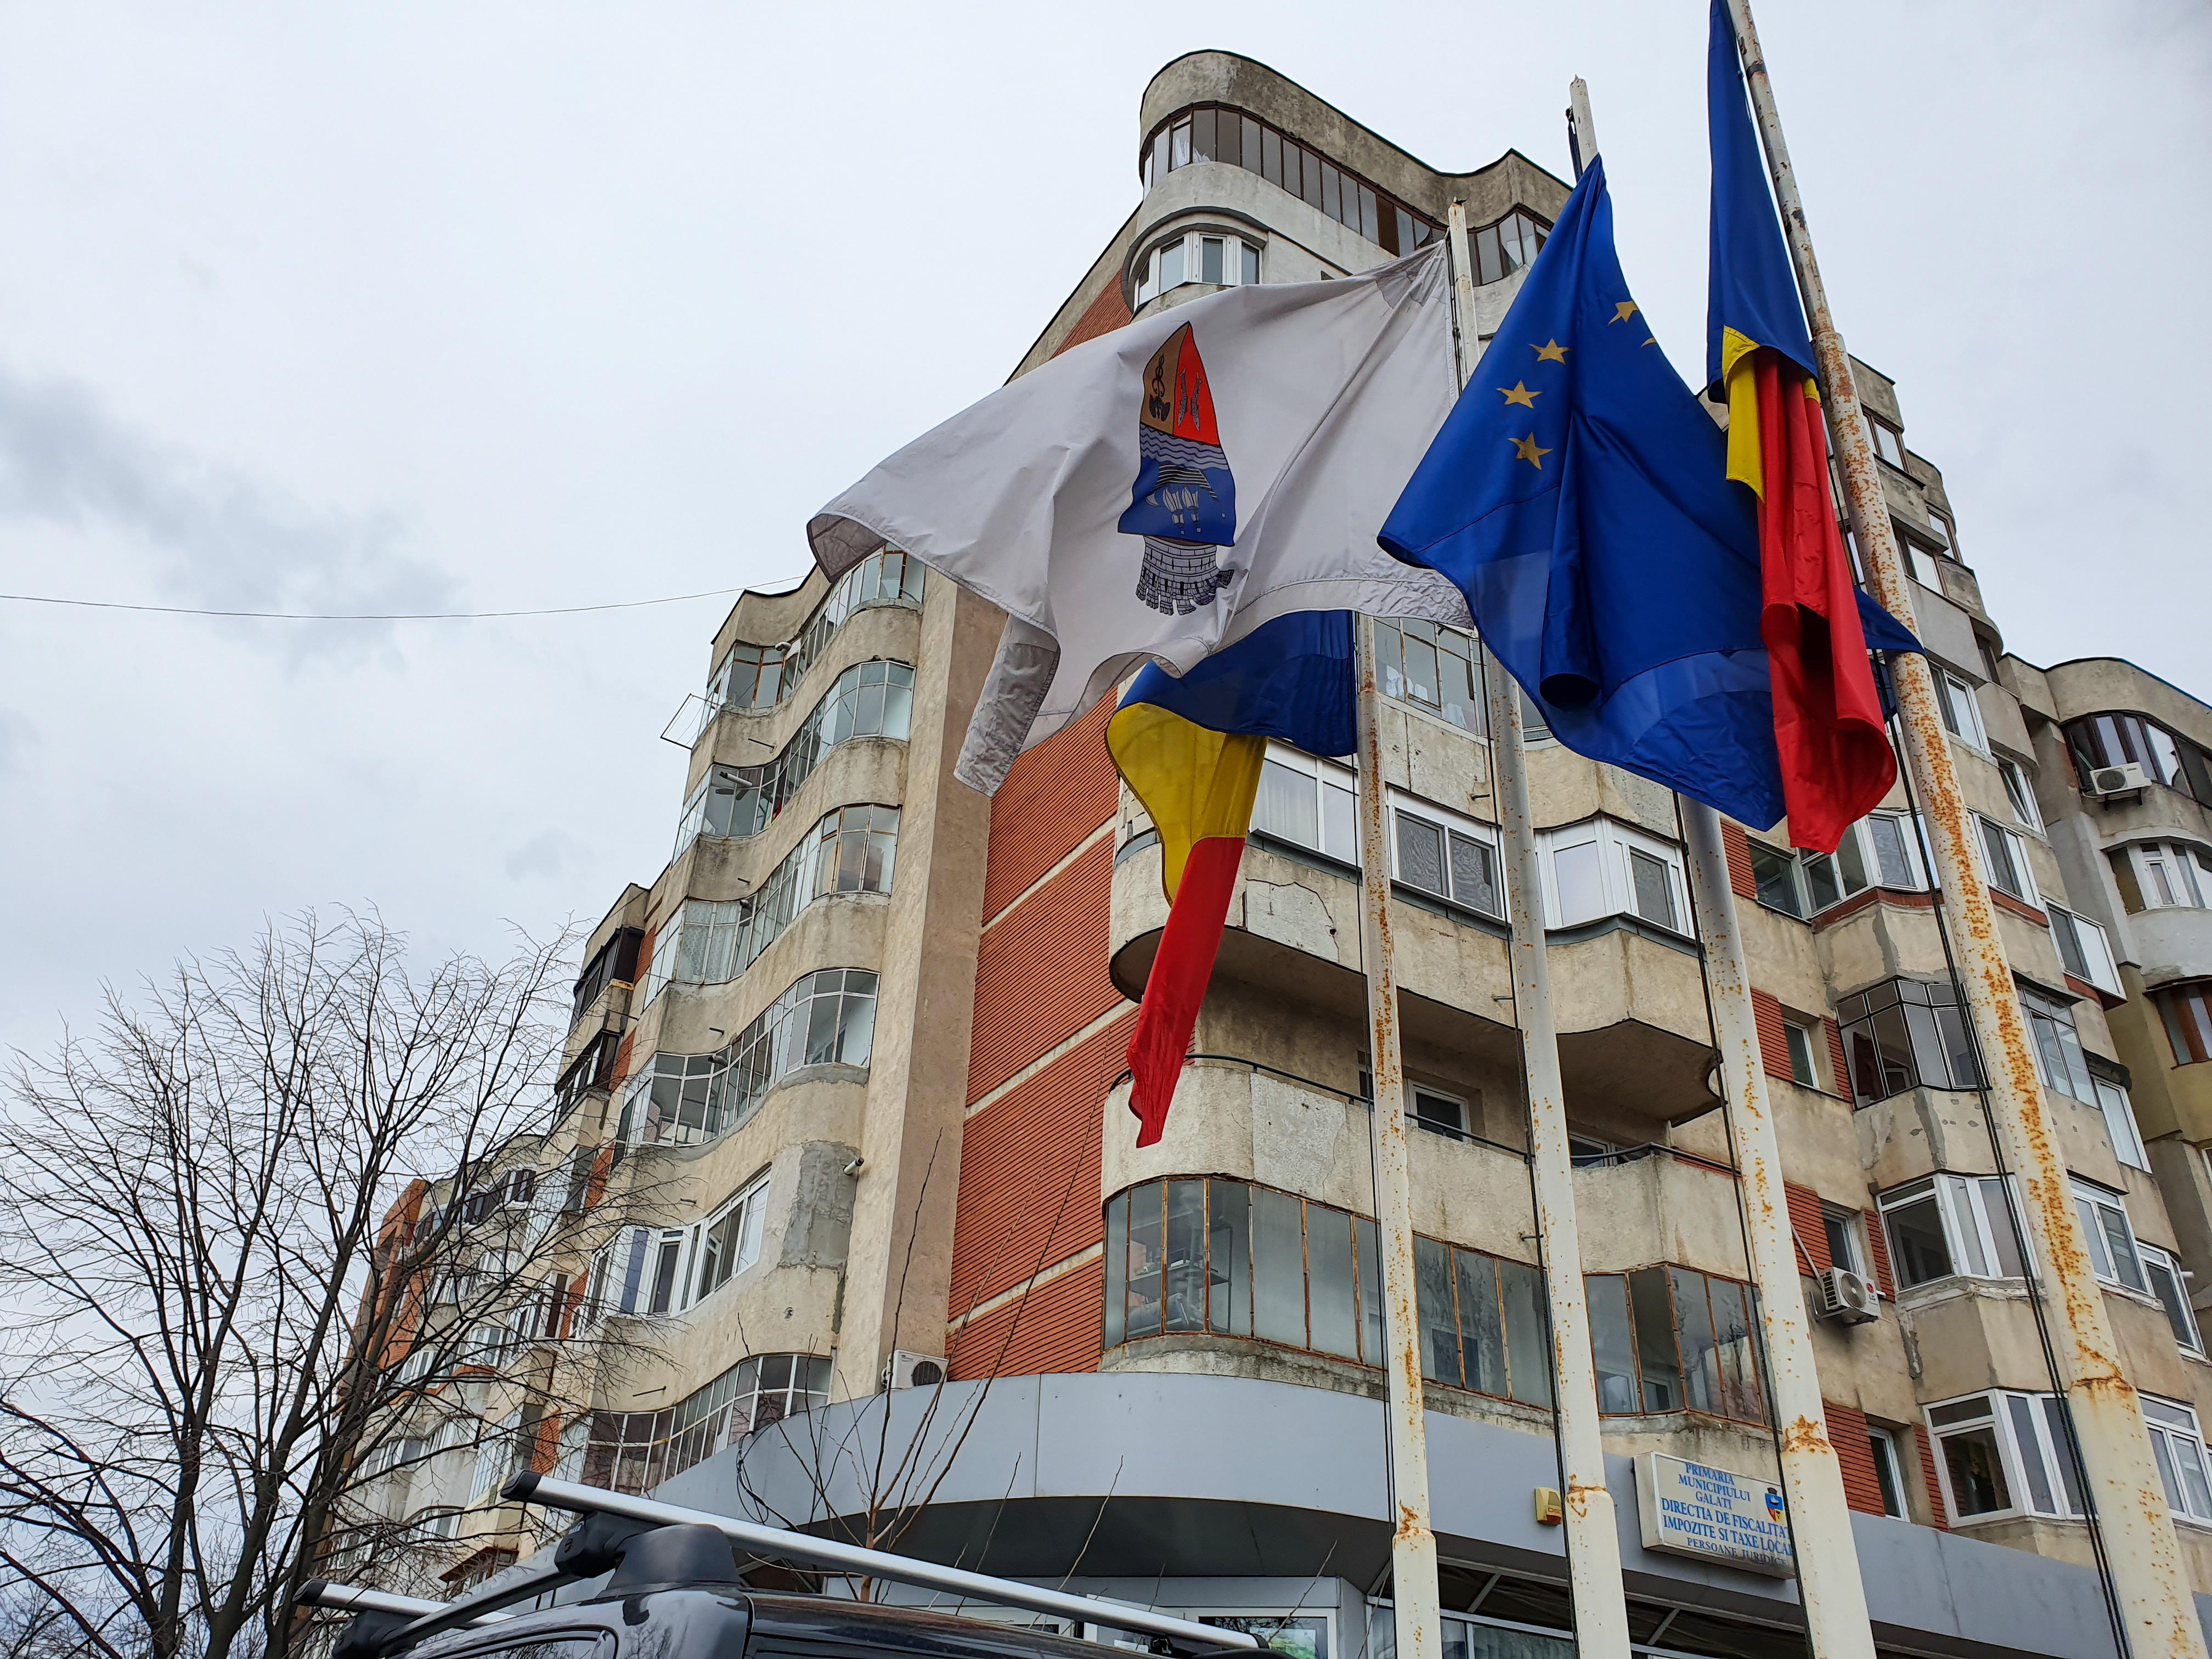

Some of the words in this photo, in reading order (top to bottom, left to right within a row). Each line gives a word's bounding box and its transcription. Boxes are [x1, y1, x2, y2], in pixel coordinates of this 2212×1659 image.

[1685, 1463, 1735, 1485] PRIMARIA
[1678, 1474, 1751, 1502] MUNICIPIULUI
[1695, 1491, 1732, 1510] GALATI
[1661, 1497, 1713, 1521] DIRECTIA
[1715, 1510, 1731, 1525] DE
[1663, 1515, 1716, 1539] IMPOZITE
[1718, 1527, 1729, 1542] SI
[1730, 1530, 1759, 1548] TAXE
[1687, 1537, 1737, 1557] PERSOANE
